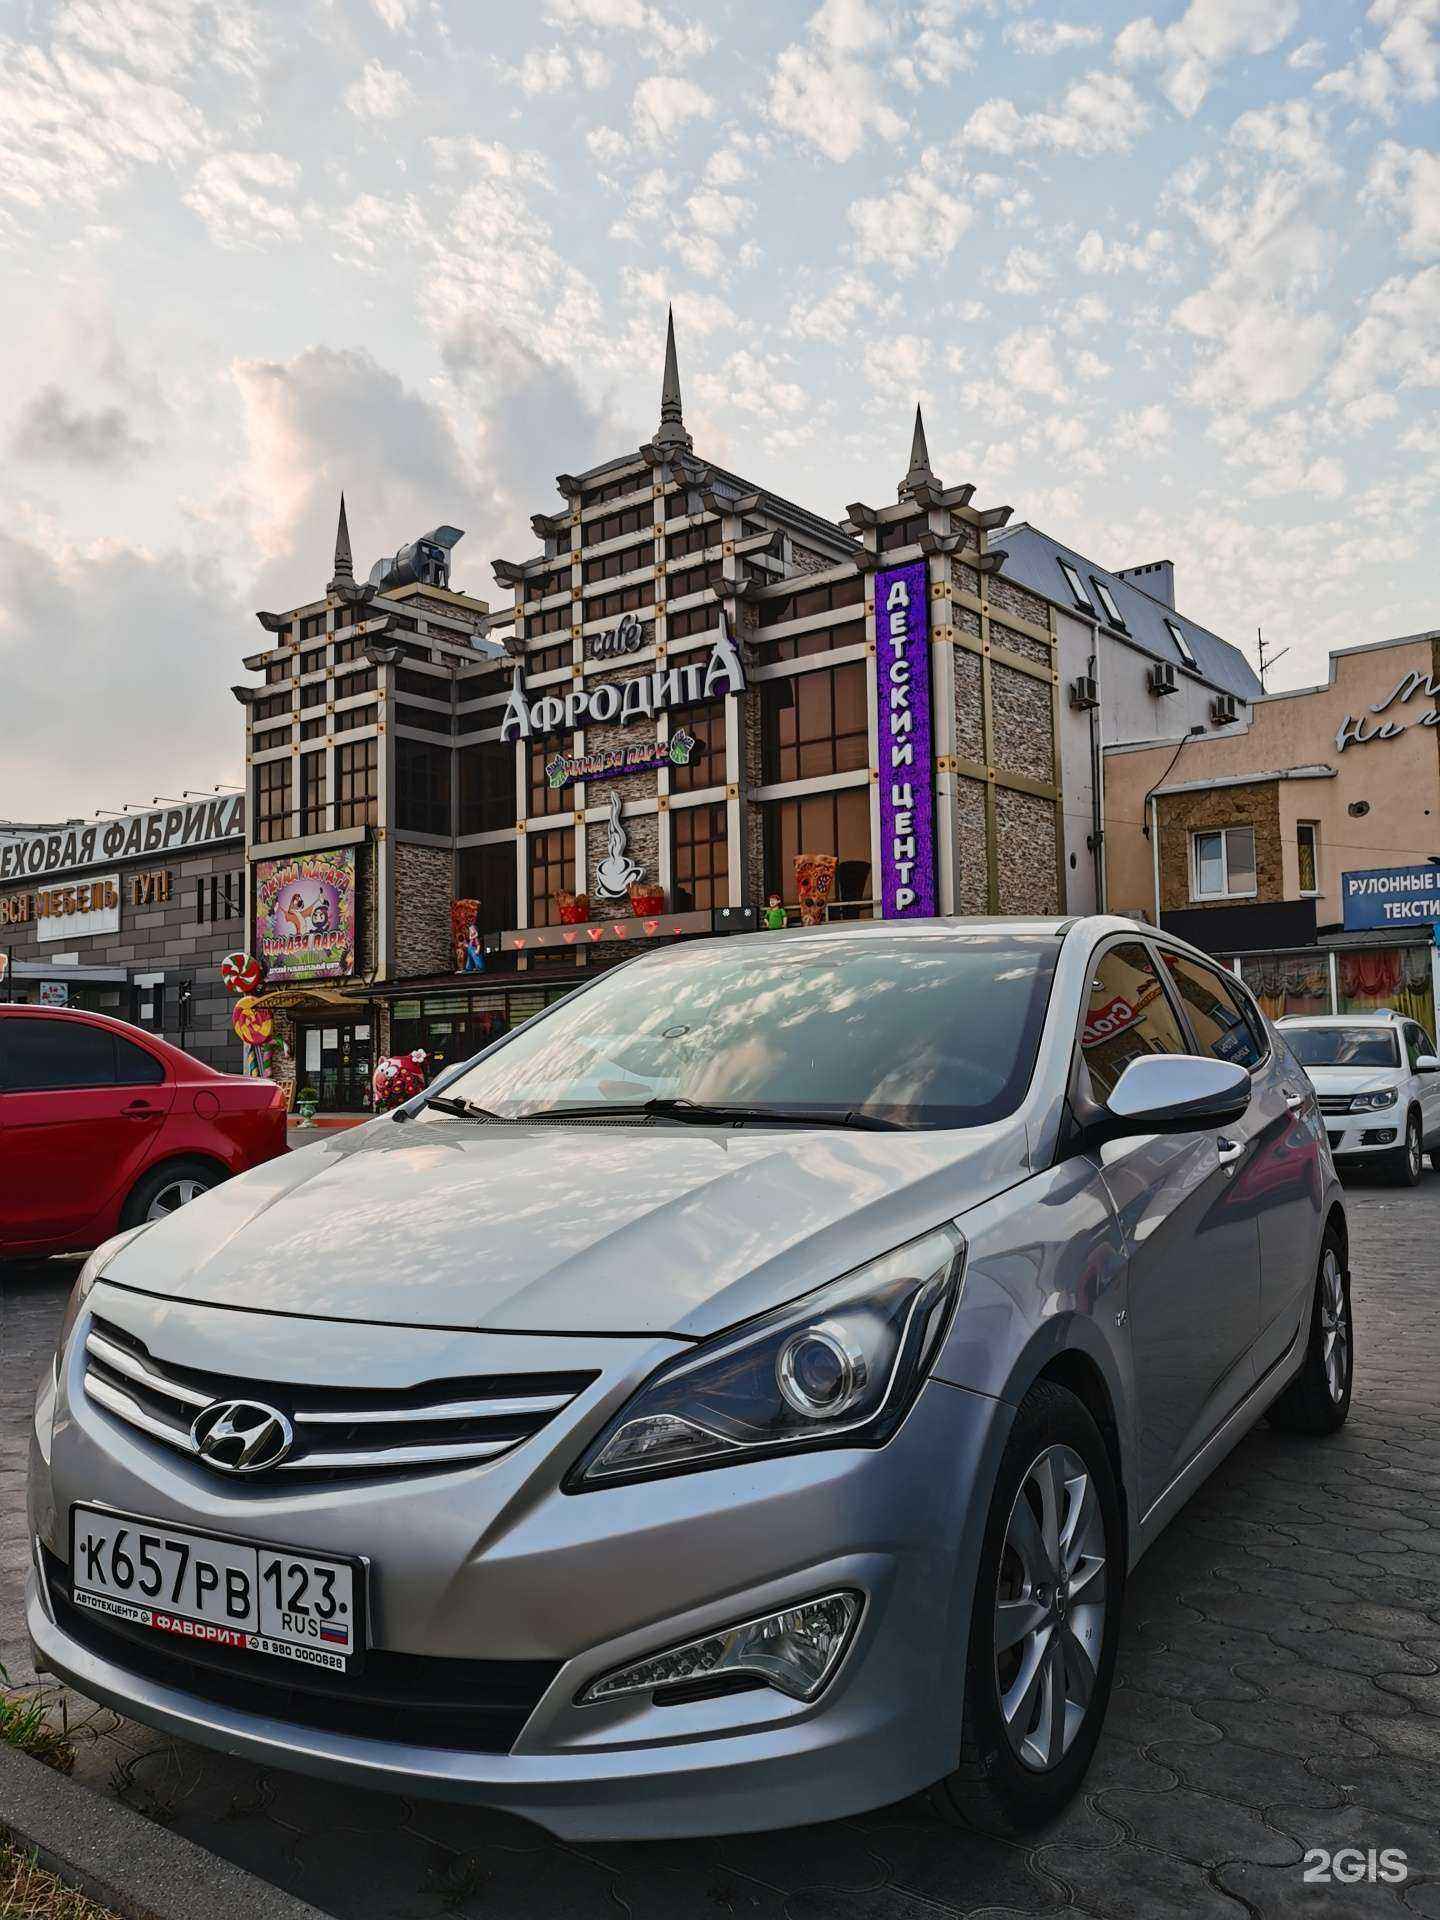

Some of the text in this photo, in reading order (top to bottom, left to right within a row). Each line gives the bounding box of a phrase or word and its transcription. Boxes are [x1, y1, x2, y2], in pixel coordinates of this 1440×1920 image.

[591, 614, 642, 661] cafe
[500, 609, 746, 742] АФРОДИТА
[626, 741, 669, 765] ПАРК
[886, 580, 916, 911] ДЕТСКИЙ ЦЕНТР
[102, 796, 245, 859] ФАБРИКА
[35, 881, 119, 918] МЕБЕЛЬ
[128, 869, 171, 906] ТУТ!
[1349, 873, 1434, 896] РУЛОННЫЕ
[263, 930, 348, 956] НИНДЗЯ ПАРК
[263, 1559, 336, 1620] 123
[76, 1593, 139, 1619] АВТОТЕХЦЕНТР
[156, 1615, 240, 1647] ФАВОРИТ
[271, 1642, 292, 1656] 980
[294, 1648, 343, 1669] 0000628
[281, 1612, 318, 1638] RUS
